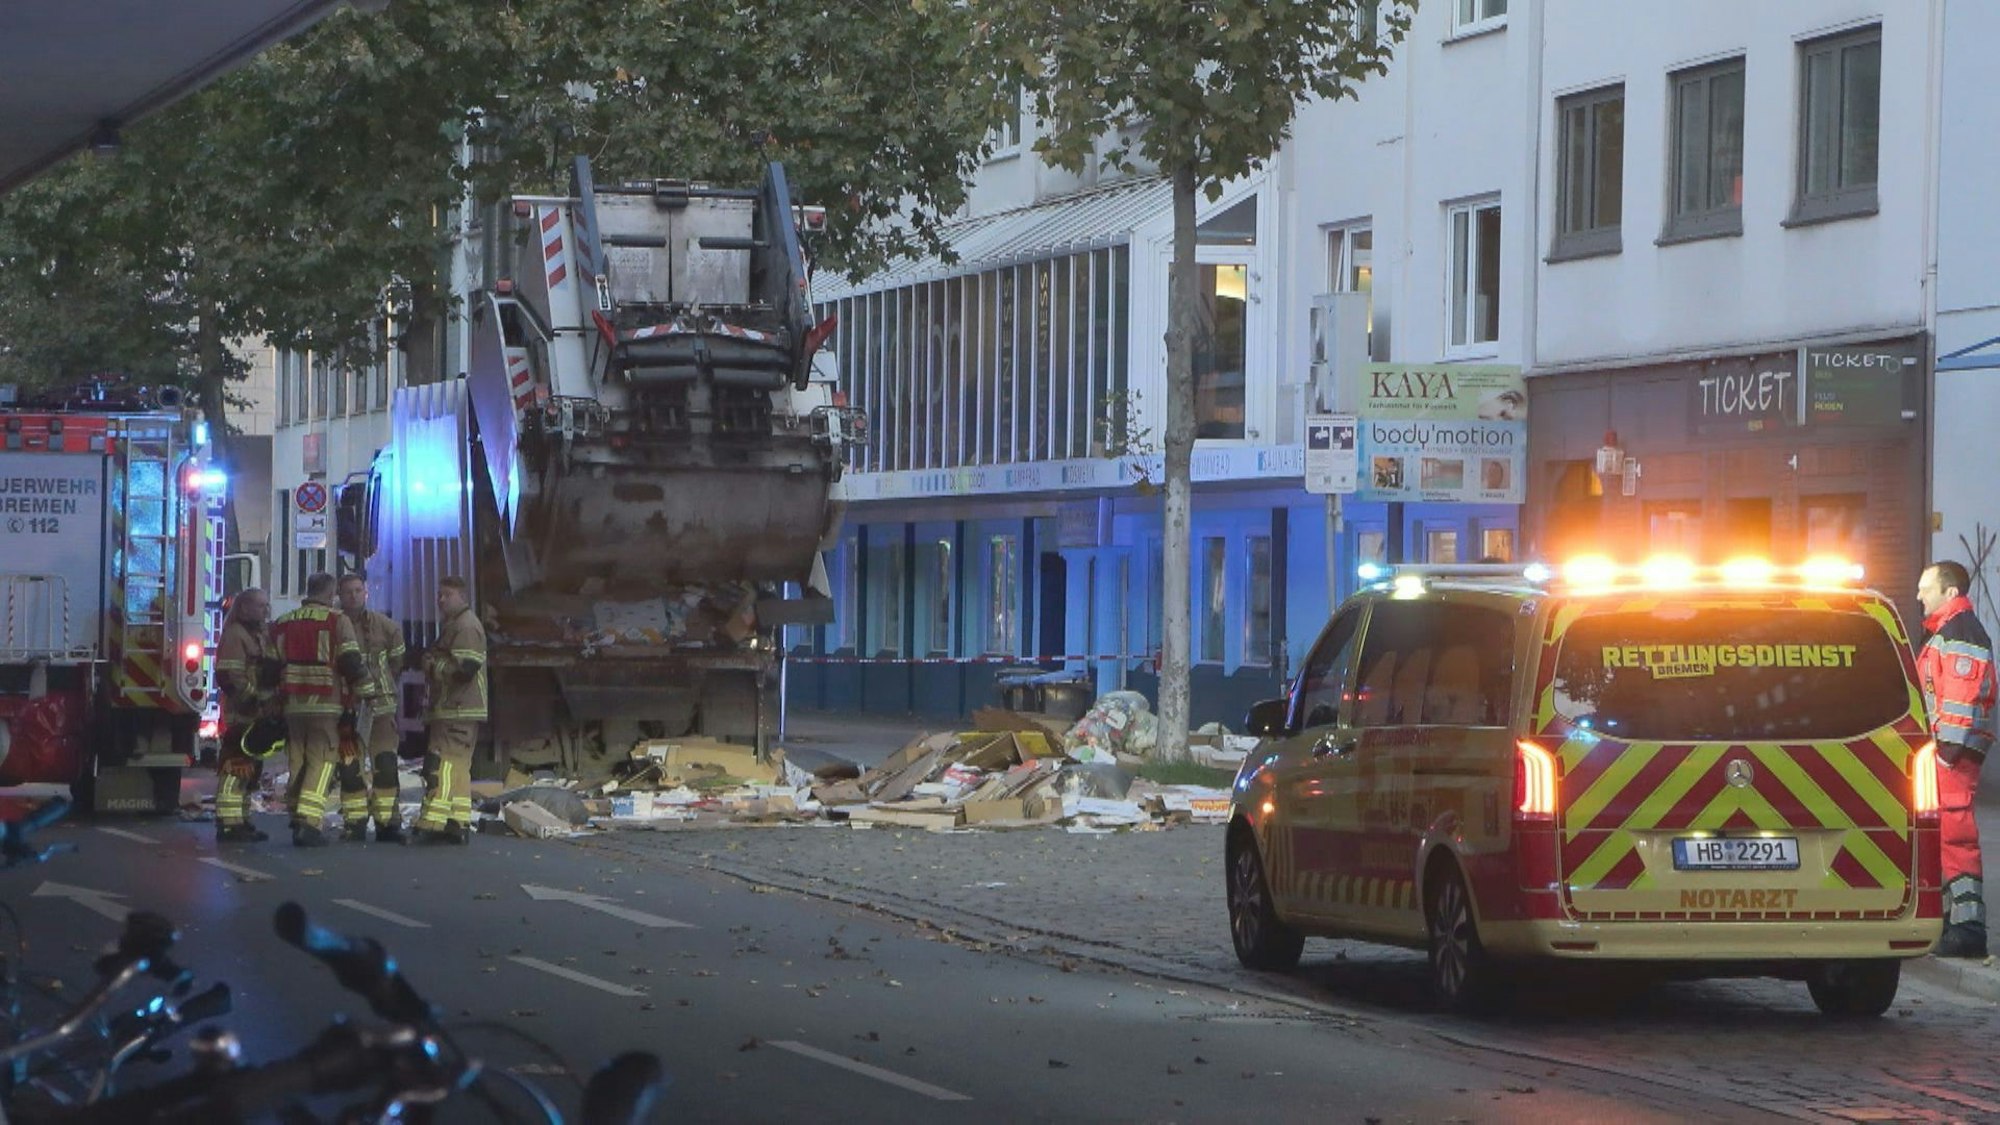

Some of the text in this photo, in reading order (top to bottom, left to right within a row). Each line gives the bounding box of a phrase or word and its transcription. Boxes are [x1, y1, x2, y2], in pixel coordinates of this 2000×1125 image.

[1810, 352, 1892, 368] TICKET
[1369, 371, 1456, 399] KAYA
[1699, 371, 1792, 416] TICKET
[1372, 422, 1513, 450] body'motion
[0, 497, 77, 515] REMEN
[28, 517, 60, 534] 112
[1602, 644, 1857, 668] RETTUNGSDIENST
[1657, 663, 1711, 677] BREMEN
[1696, 842, 1788, 862] HB 2291
[1680, 888, 1799, 909] NOTARZT
